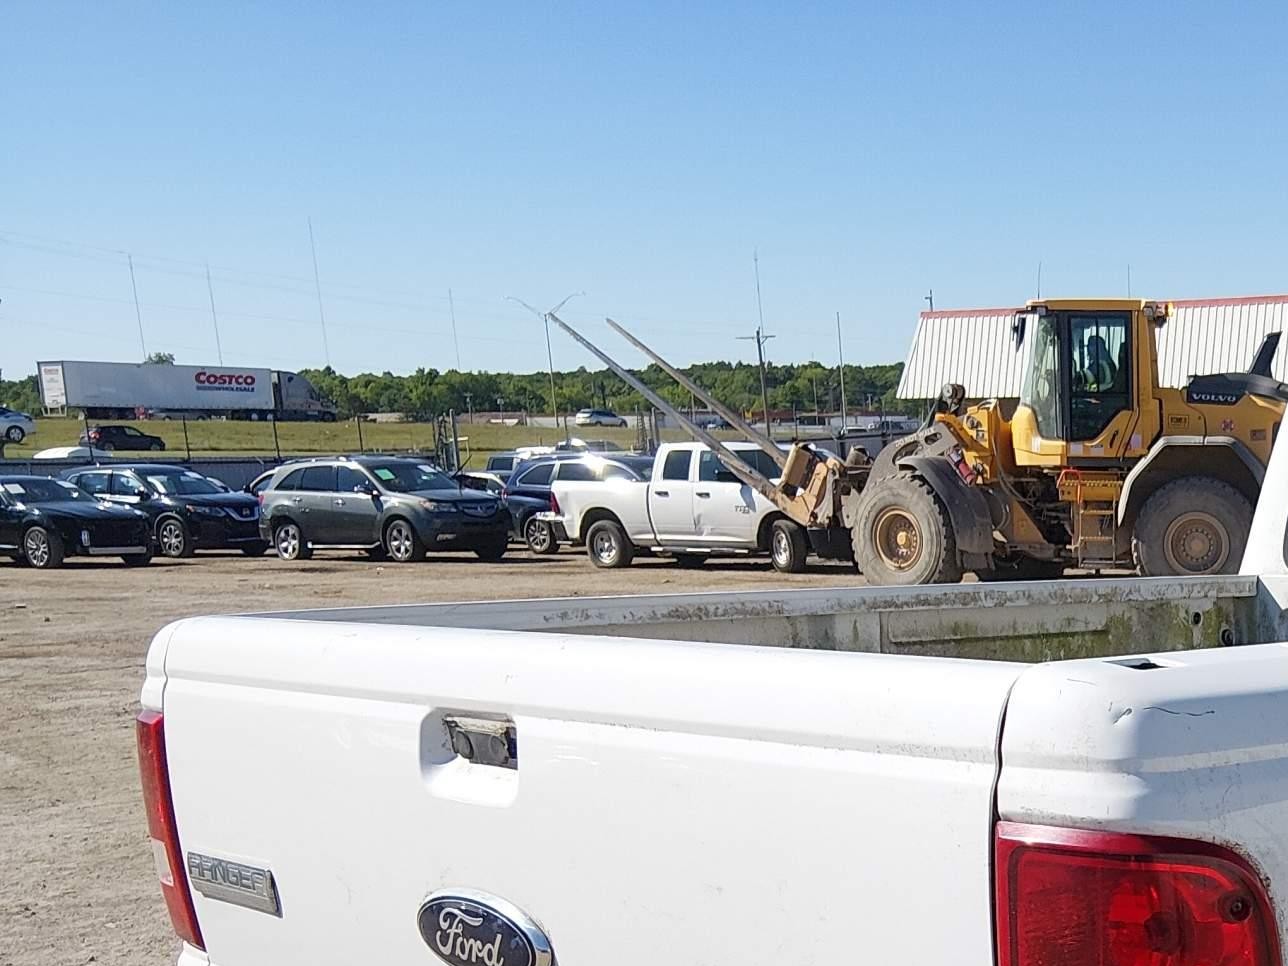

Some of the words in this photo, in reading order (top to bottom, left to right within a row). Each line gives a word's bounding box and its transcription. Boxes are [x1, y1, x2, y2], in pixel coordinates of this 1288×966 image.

[194, 371, 256, 386] COSTCO
[1192, 393, 1236, 402] VOLVO
[187, 852, 266, 897] RANGER
